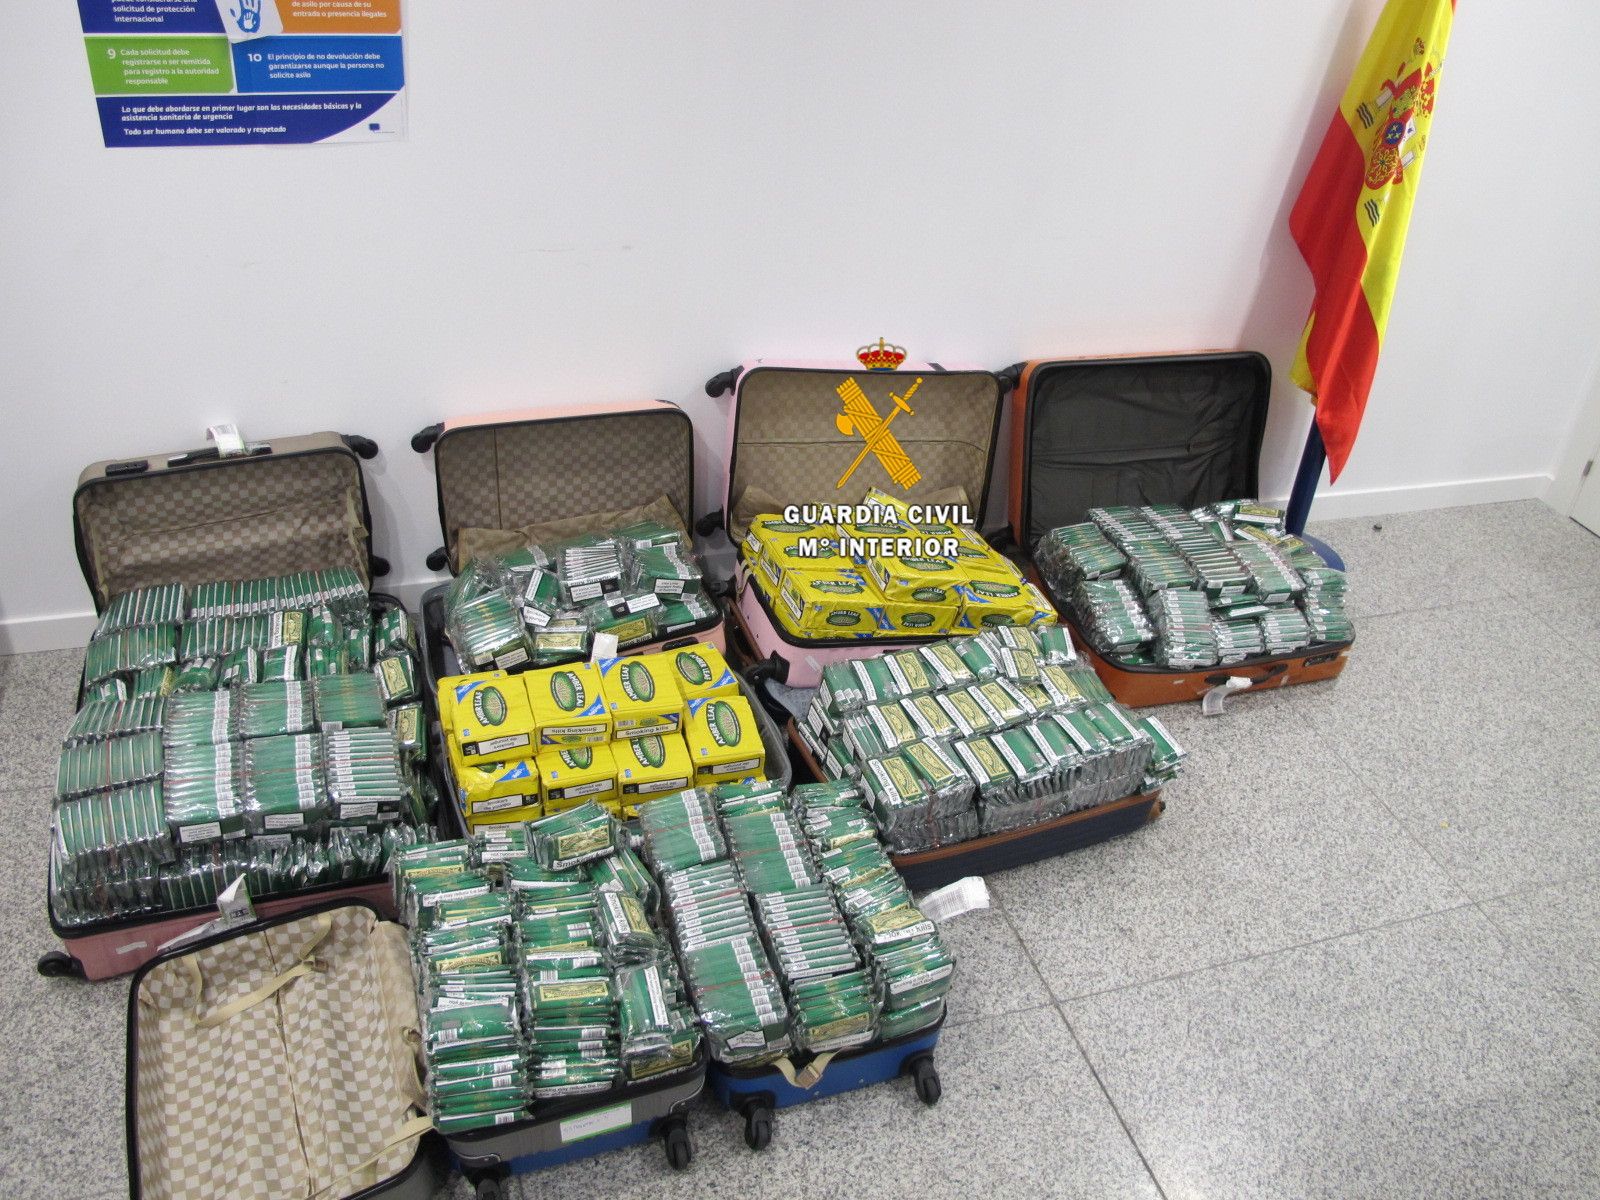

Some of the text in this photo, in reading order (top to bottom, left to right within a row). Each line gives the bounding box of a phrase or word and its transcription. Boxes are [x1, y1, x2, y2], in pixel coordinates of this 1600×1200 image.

[319, 1, 331, 9] por
[353, 0, 362, 8] de
[113, 5, 196, 14] solicitud de protección
[361, 10, 388, 18] ilegales
[115, 15, 164, 23] internacional
[107, 48, 116, 59] 9
[120, 48, 190, 56] Cada solicitud debe
[122, 58, 161, 66] registrarse
[247, 53, 262, 62] 10
[275, 53, 306, 62] principio
[268, 62, 312, 71] garantizarse
[339, 61, 346, 69] la
[141, 67, 170, 76] registro
[176, 66, 184, 74] la
[184, 66, 219, 74] autoridad
[269, 71, 295, 79] solicite
[126, 77, 168, 86] responsable
[147, 105, 163, 113] debe
[211, 105, 235, 113] primer
[236, 104, 255, 112] lugar
[323, 102, 349, 110] básicas
[121, 114, 158, 122] asistencia
[159, 113, 192, 121] sanitaria
[202, 112, 233, 121] urgencia
[185, 126, 202, 134] debe
[215, 126, 246, 134] valorado
[246, 127, 252, 135] y
[252, 125, 287, 134] respetado
[707, 704, 726, 745] AMBER LEAF
[566, 726, 598, 735] Smoking
[624, 724, 669, 737] Smoking kills
[559, 749, 577, 768] AMBE
[871, 760, 889, 788] Smoking
[887, 787, 900, 802] kills
[915, 923, 933, 932] kills
